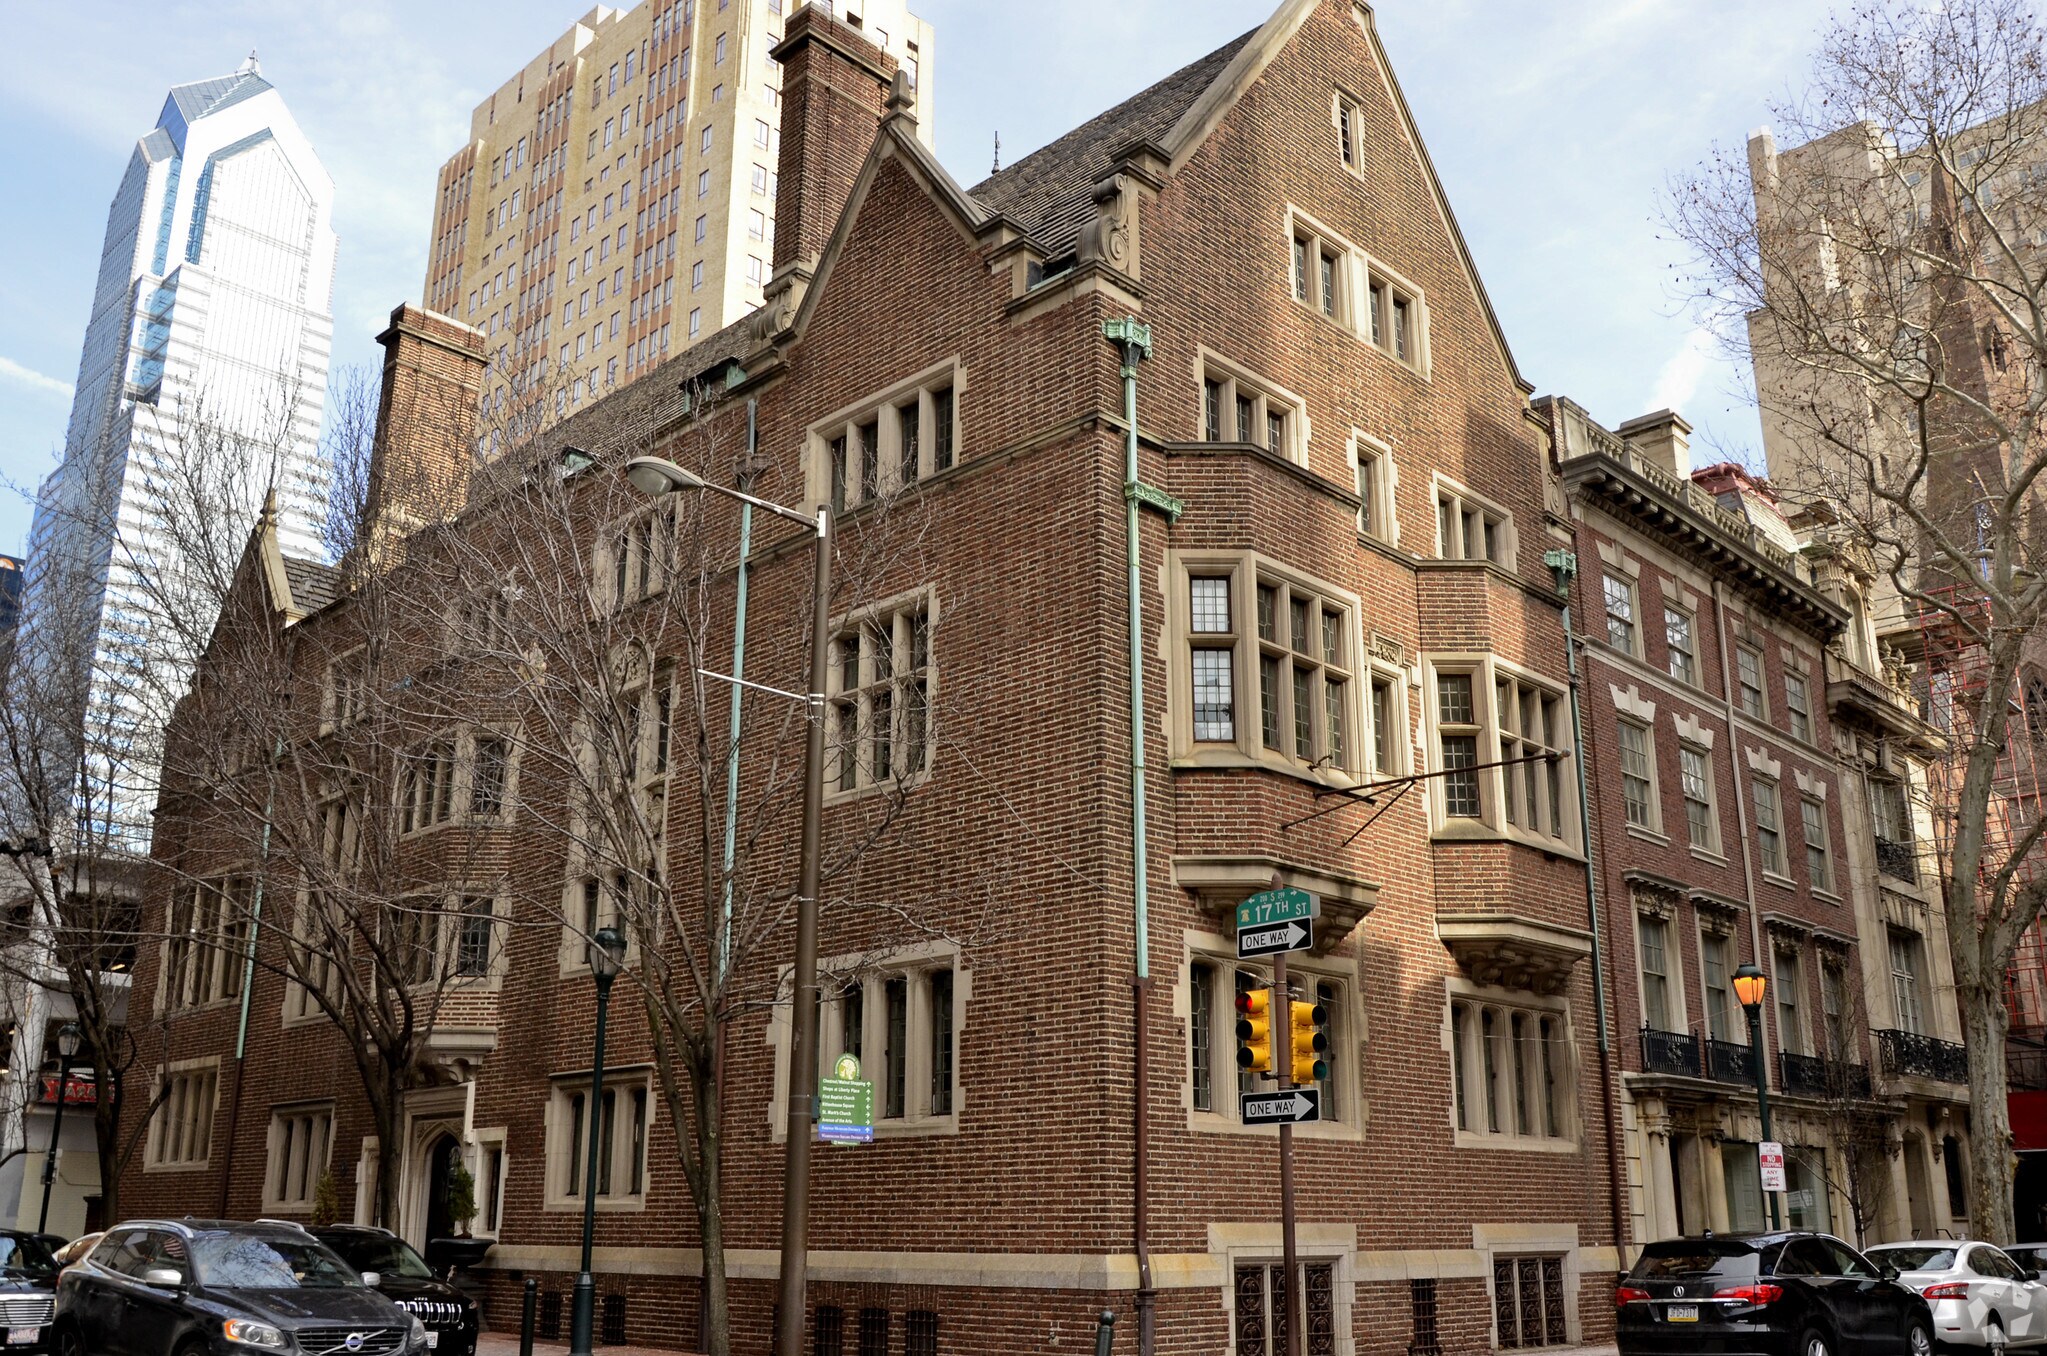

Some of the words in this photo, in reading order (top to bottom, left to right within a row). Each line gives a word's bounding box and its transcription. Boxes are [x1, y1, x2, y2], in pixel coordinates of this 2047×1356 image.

[1270, 892, 1275, 902] S
[1296, 902, 1306, 916] ST
[1246, 934, 1266, 948] ONE
[1270, 930, 1288, 944] WAY
[1250, 1103, 1271, 1116] ONE
[1274, 1101, 1295, 1114] WAY
[1767, 1154, 1776, 1162] NO
